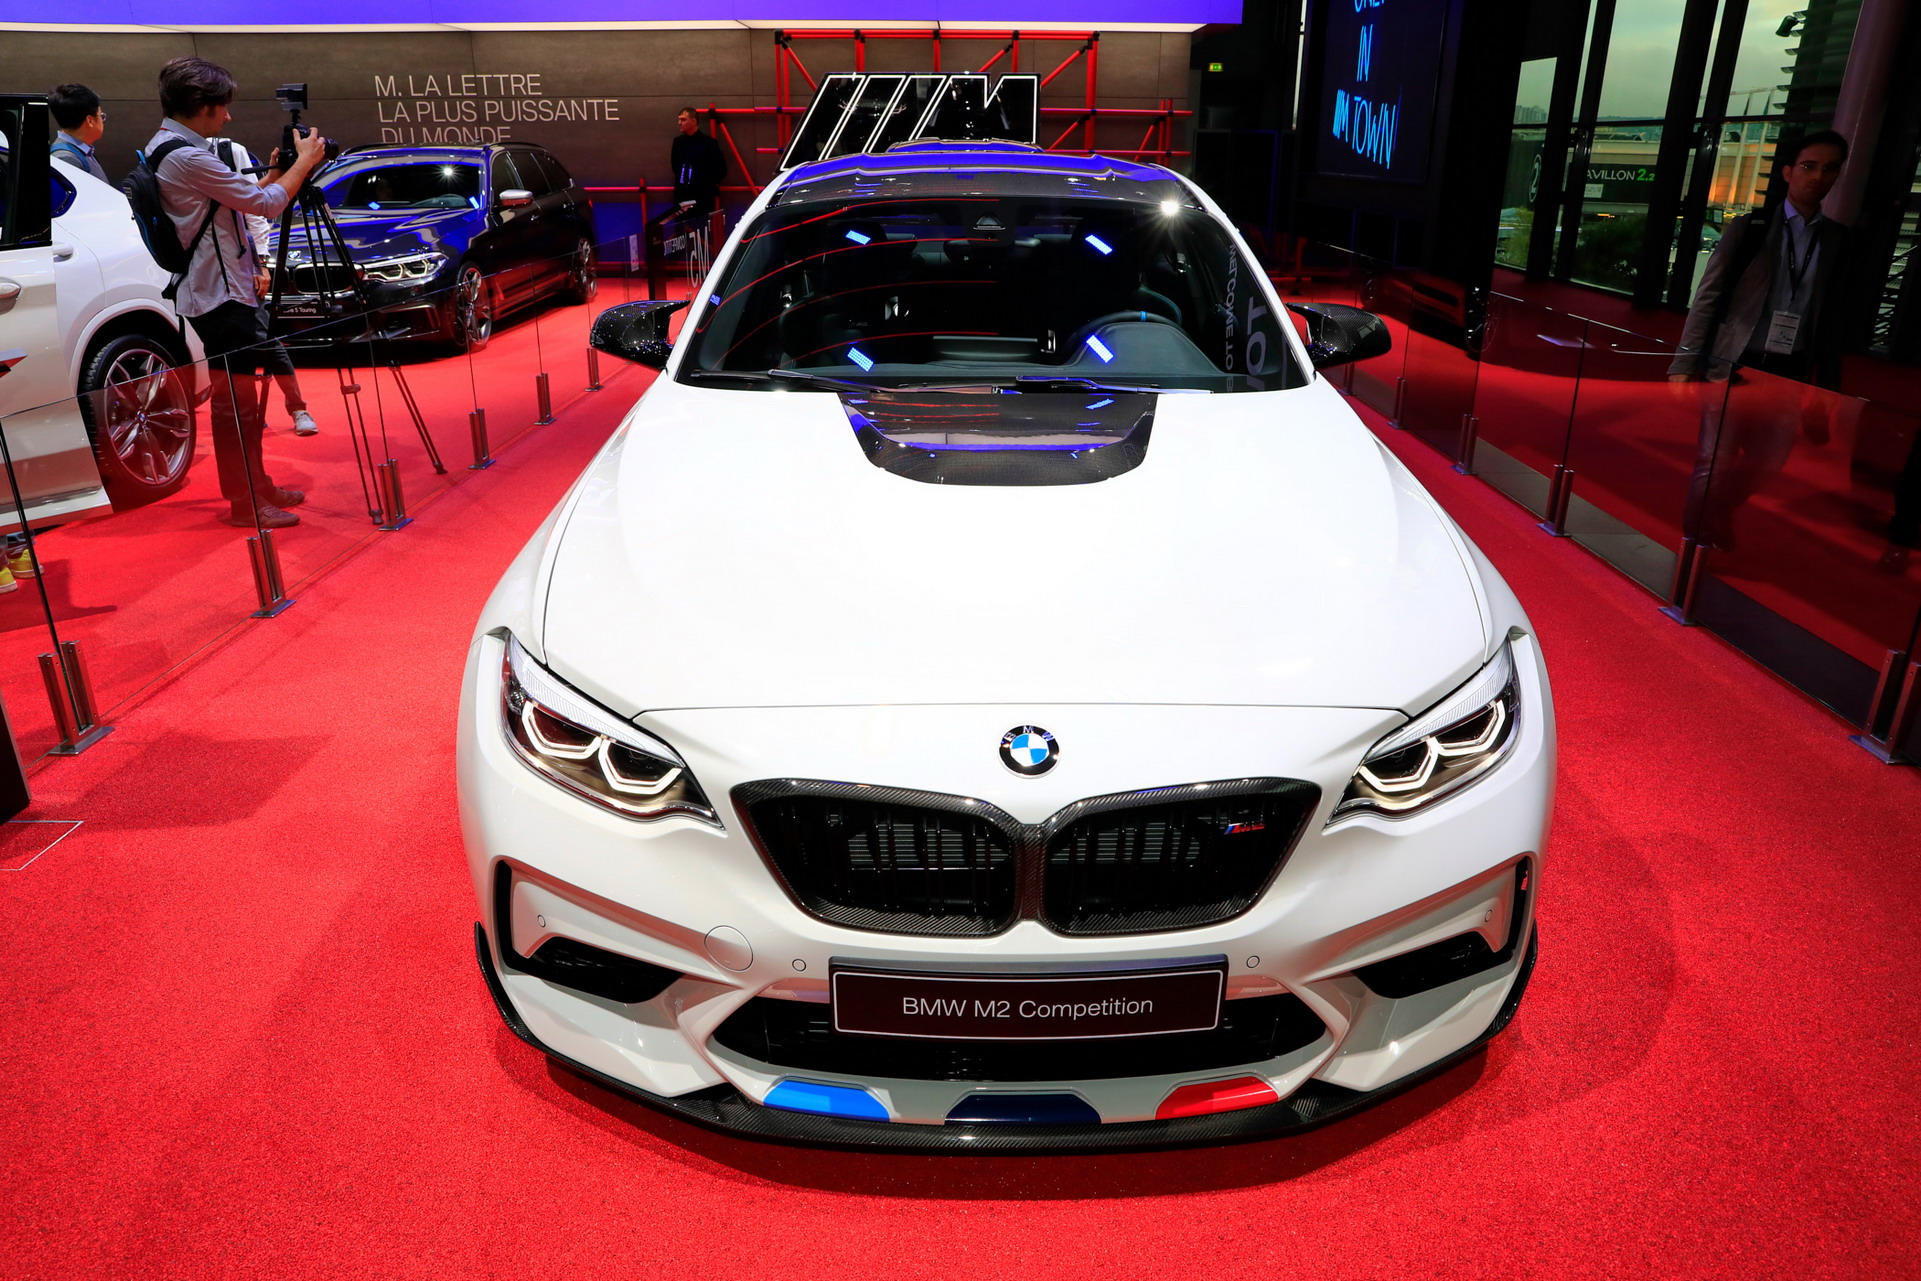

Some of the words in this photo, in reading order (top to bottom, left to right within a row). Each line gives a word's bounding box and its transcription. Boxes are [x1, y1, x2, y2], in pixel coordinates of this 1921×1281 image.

[1356, 24, 1373, 82] IN
[374, 75, 402, 97] M.
[409, 75, 441, 96] LA
[447, 73, 542, 96] LETTRE
[378, 101, 410, 123] LA
[416, 100, 477, 123] PLUS
[485, 99, 620, 122] PUISSANTE
[381, 127, 414, 143] DU
[422, 126, 511, 143] MONDE
[1352, 96, 1396, 169] TOWN
[1587, 169, 1636, 181] AVILLON
[1003, 725, 1056, 742] BMW
[902, 997, 966, 1017] BMW
[974, 1000, 1010, 1018] M2
[1019, 997, 1153, 1021] Competition
